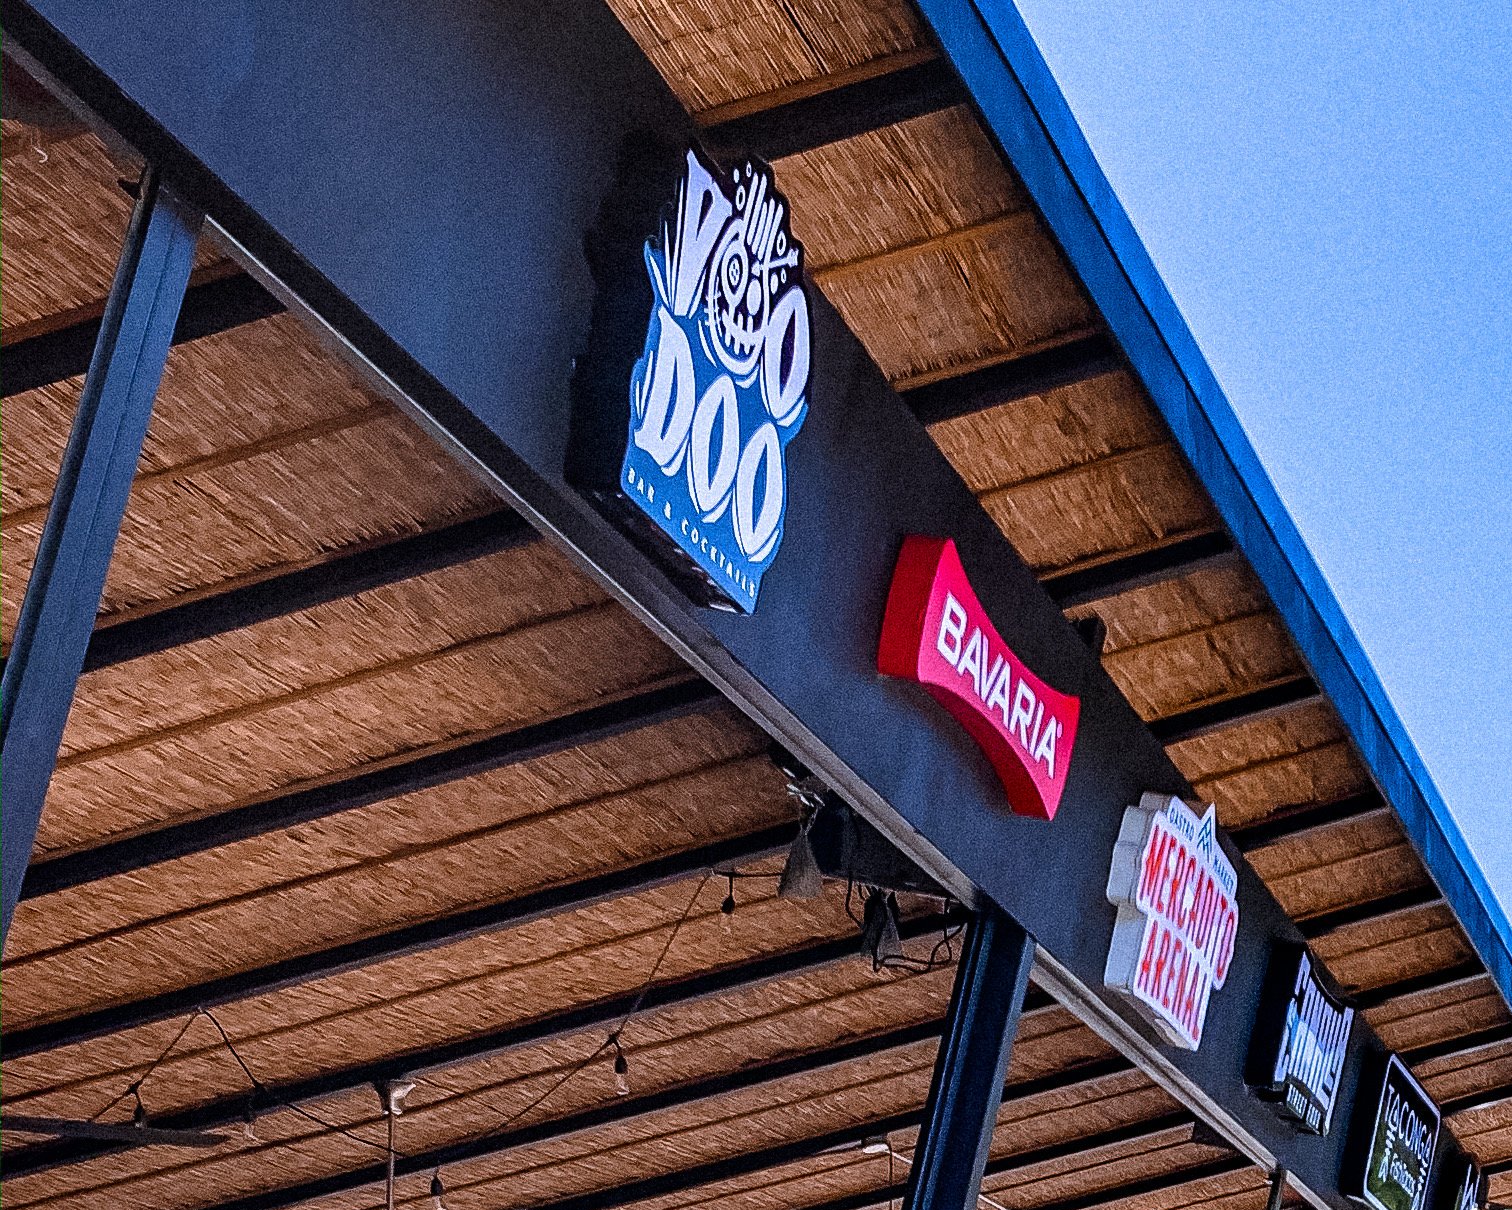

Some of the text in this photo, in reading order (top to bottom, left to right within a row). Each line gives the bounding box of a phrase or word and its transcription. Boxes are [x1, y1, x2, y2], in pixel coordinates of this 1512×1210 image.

[627, 466, 655, 503] BAR
[681, 517, 756, 598] COCKTAILS
[937, 588, 1054, 778] BAVARIA
[1169, 808, 1195, 843] GASTRO
[1139, 823, 1236, 979] MERCADITO
[1137, 919, 1208, 1041] ARENAL
